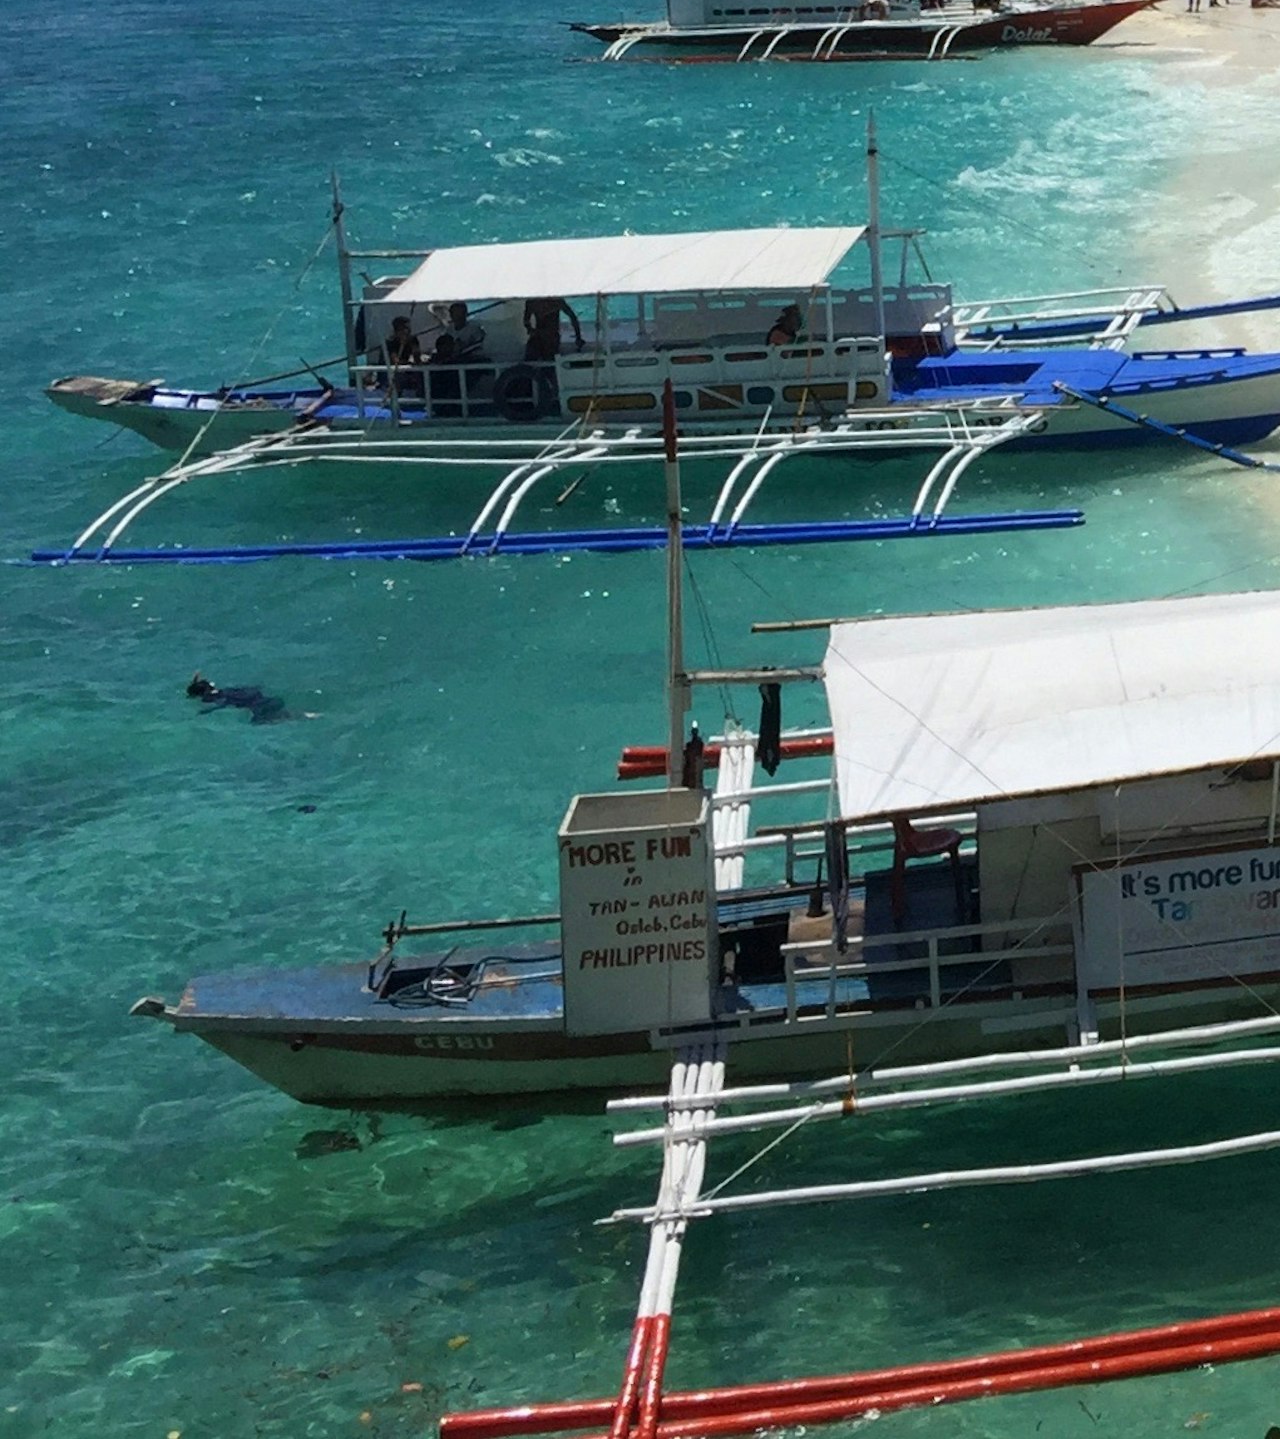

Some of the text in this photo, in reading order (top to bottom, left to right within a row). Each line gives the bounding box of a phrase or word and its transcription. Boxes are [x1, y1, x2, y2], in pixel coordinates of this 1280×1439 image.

[623, 867, 643, 887] in
[1168, 862, 1243, 894] more
[579, 940, 705, 970] PHILIPPINES
[414, 1035, 494, 1050] CEBU
